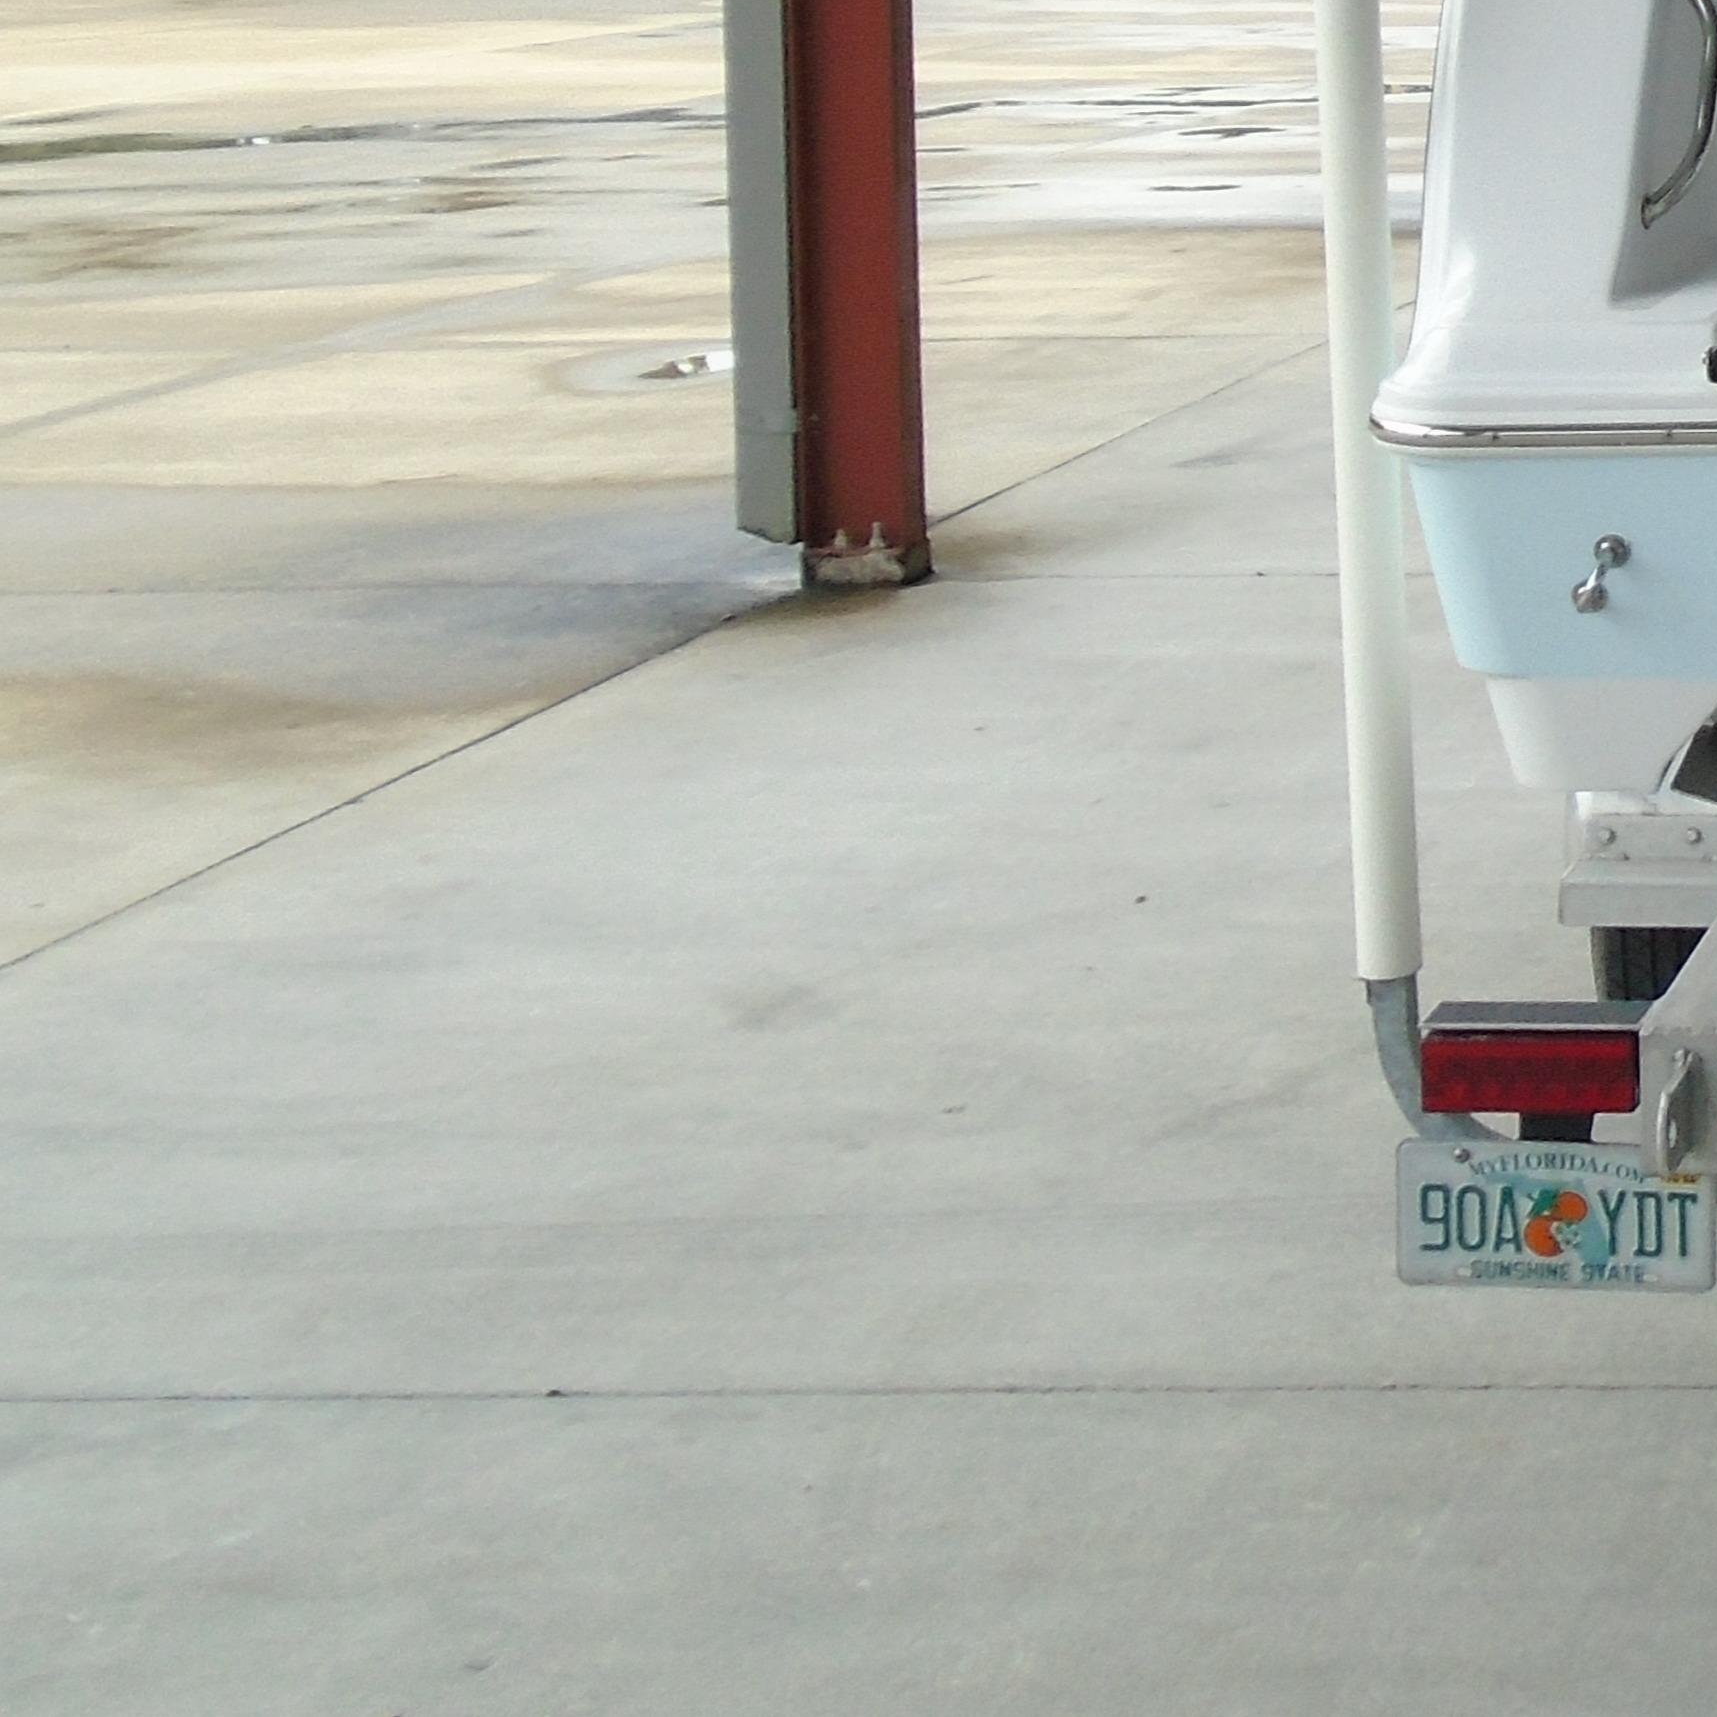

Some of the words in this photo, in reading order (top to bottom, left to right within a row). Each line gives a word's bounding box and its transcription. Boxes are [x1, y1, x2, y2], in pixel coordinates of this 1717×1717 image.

[1419, 1183, 1523, 1254] 90A
[1597, 1188, 1699, 1258] YDT
[1469, 1259, 1569, 1282] SUNSHINE
[1580, 1262, 1646, 1283] STATE
